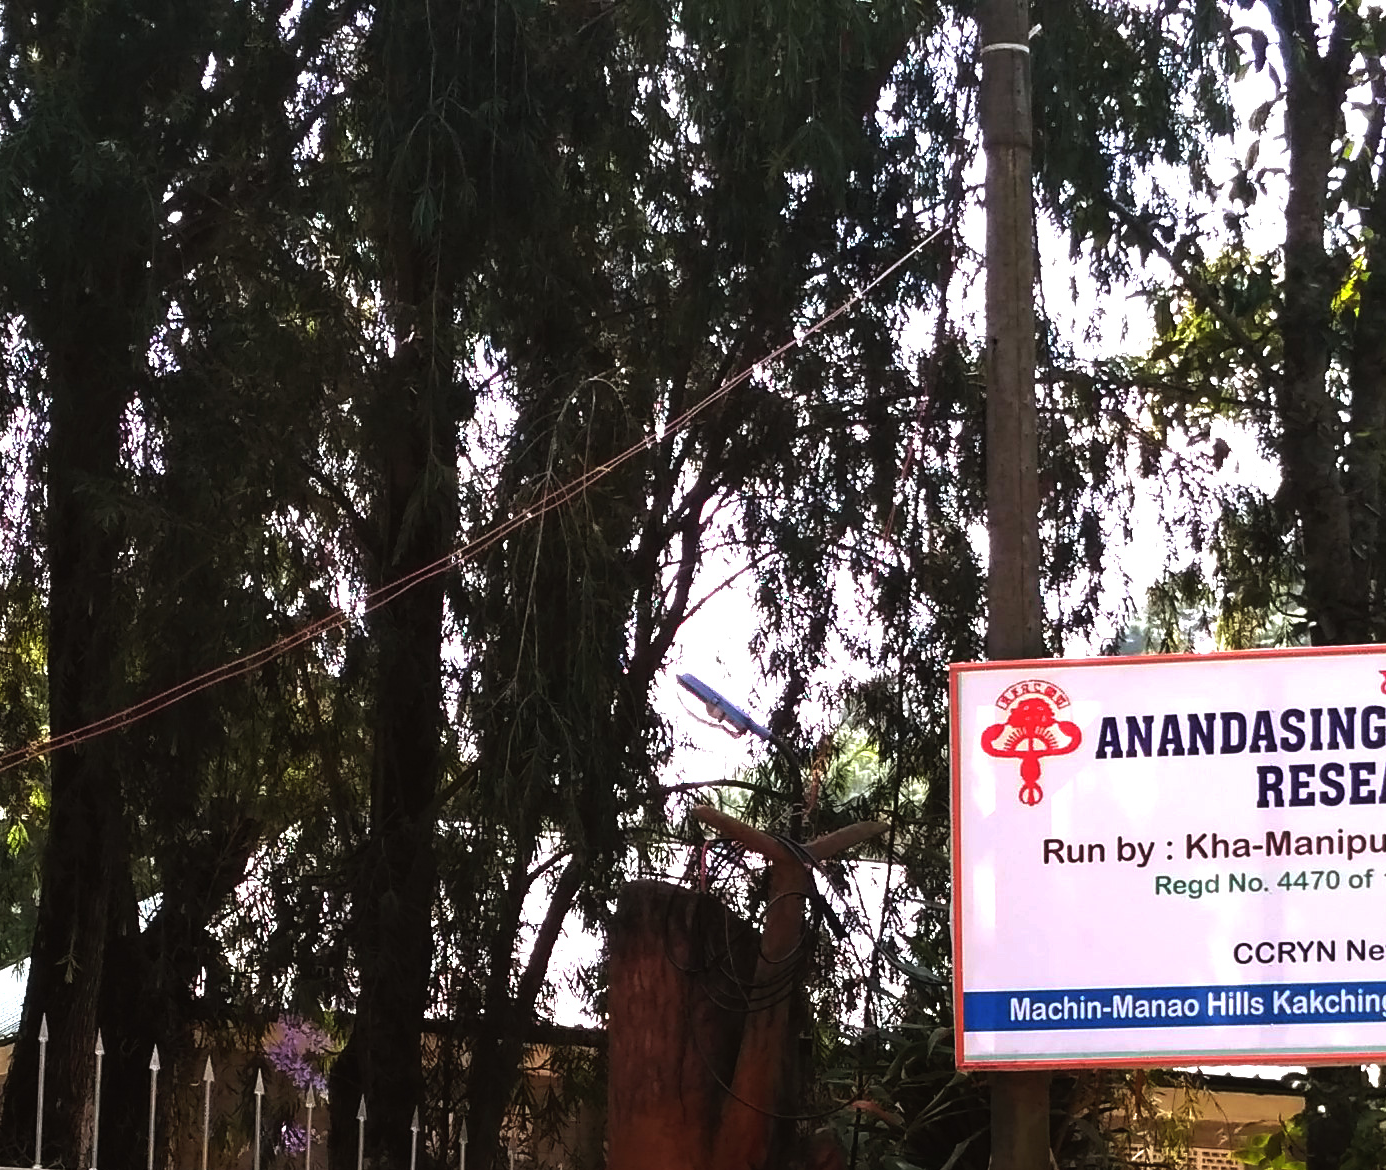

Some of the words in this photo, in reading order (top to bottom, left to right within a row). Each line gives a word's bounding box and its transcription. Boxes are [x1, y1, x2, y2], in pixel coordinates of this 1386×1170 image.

[1096, 704, 1386, 759] ANANDASING
[1044, 839, 1105, 864] Run
[1118, 836, 1155, 867] by
[1156, 874, 1219, 899] Regd
[1229, 873, 1268, 892] No.
[1277, 870, 1340, 891] 4470
[1349, 869, 1374, 888] of
[1234, 940, 1335, 964] CCRYN
[1011, 995, 1199, 1020] Machin-Manao
[1208, 992, 1264, 1016] Hills
